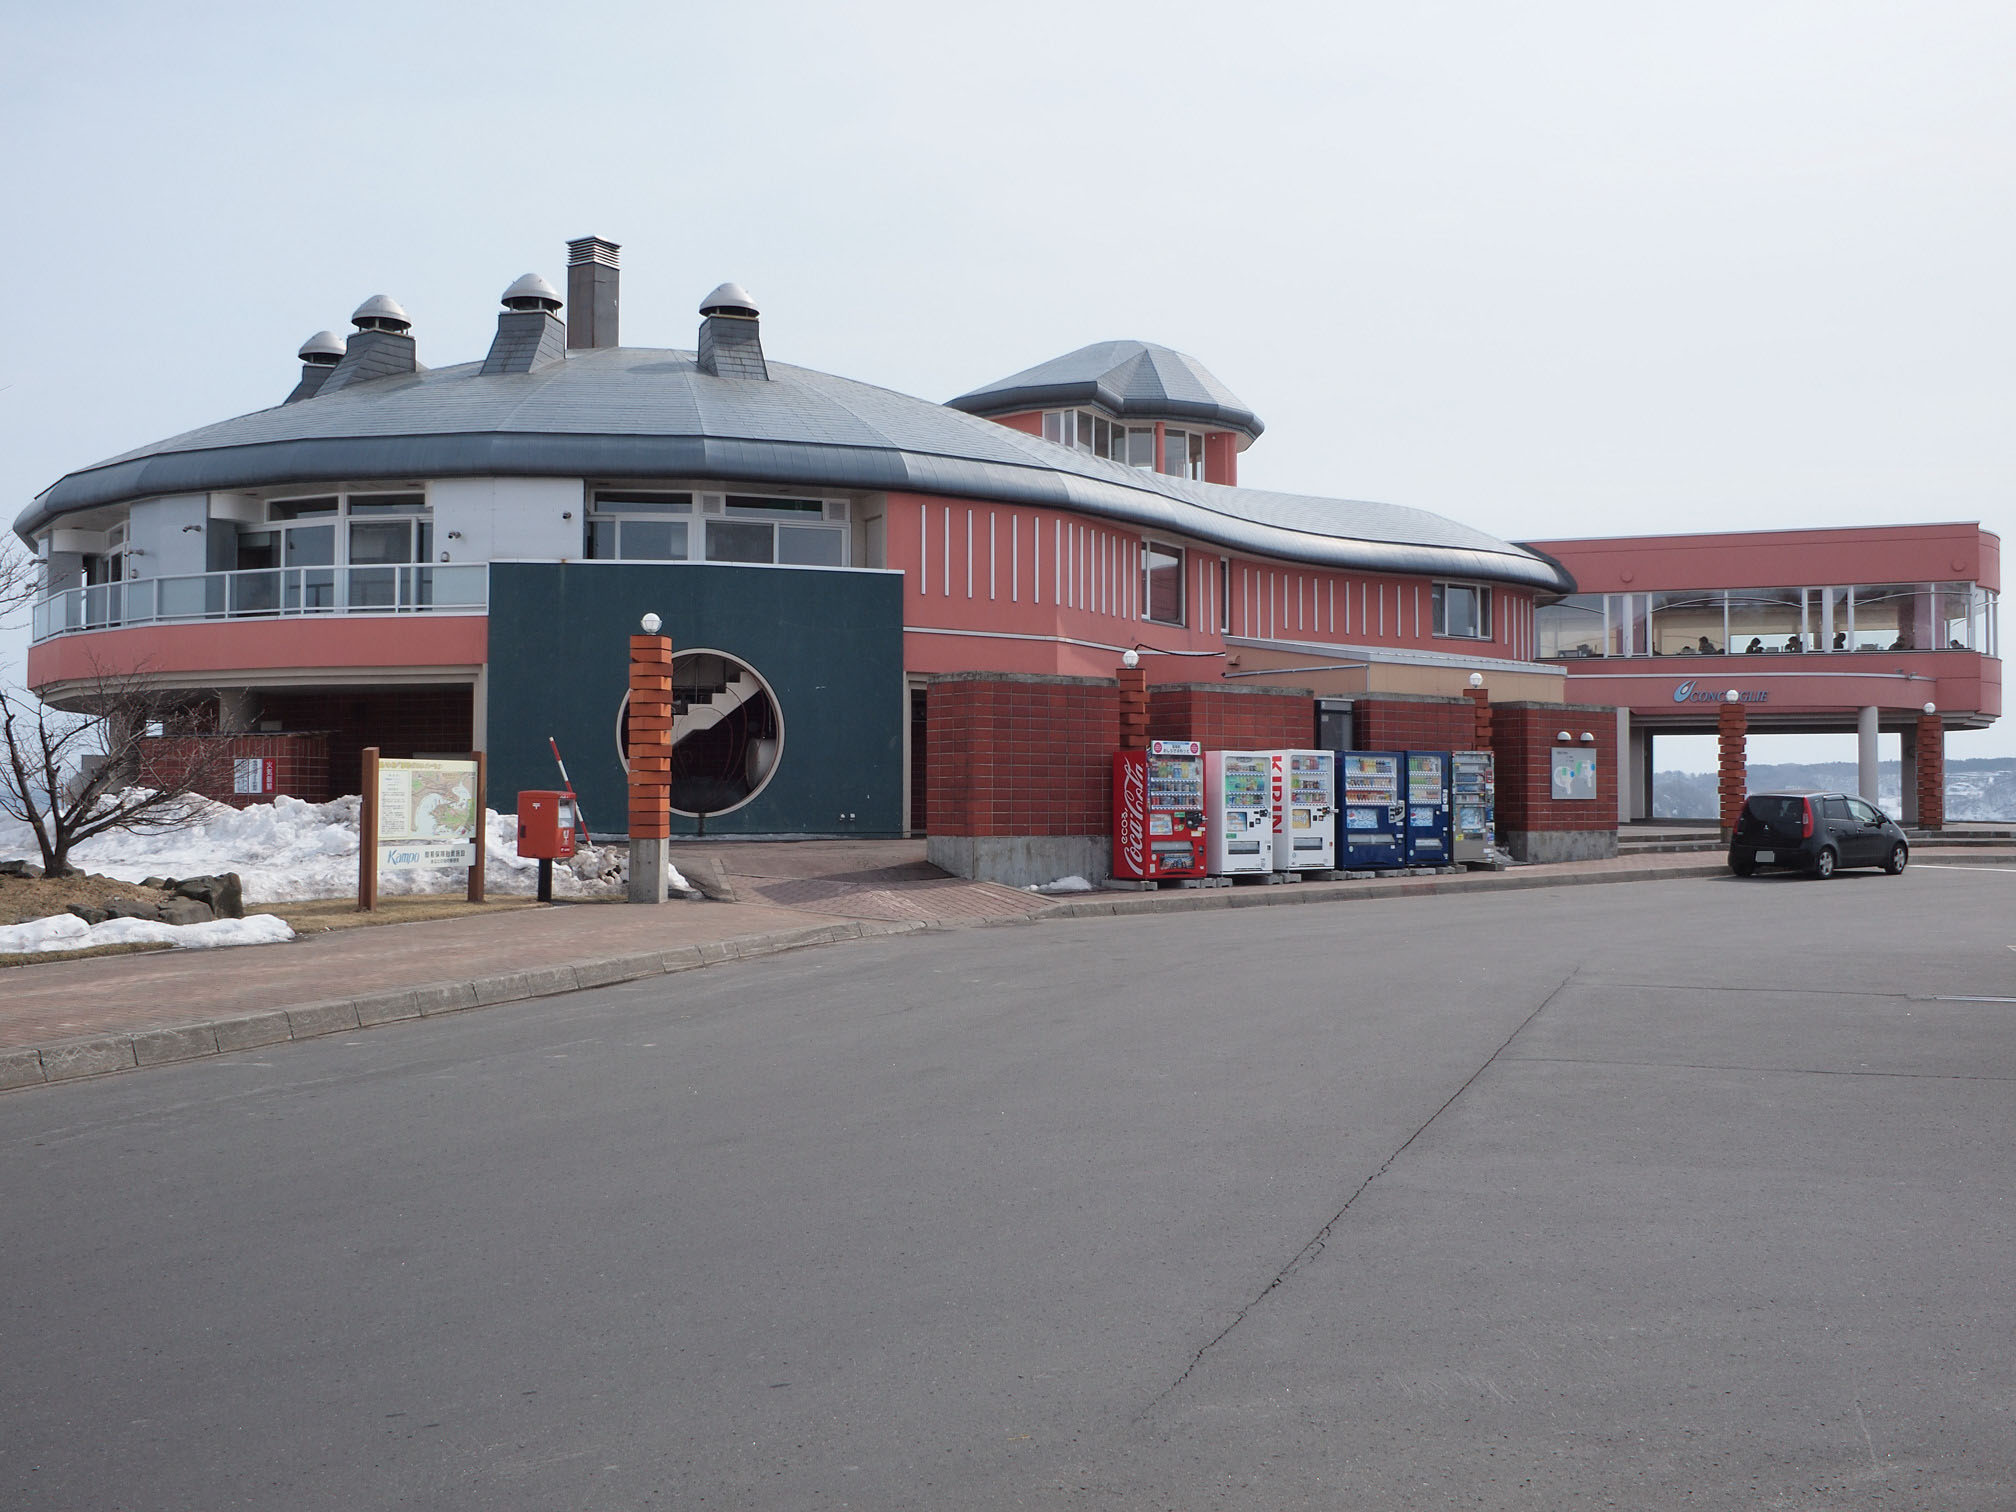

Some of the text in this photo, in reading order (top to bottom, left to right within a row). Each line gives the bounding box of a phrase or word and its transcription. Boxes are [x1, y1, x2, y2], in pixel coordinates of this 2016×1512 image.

[1690, 690, 1768, 703] CONCGLIE
[1124, 756, 1144, 876] Coca-Cola
[1272, 756, 1282, 834] KIRIN
[387, 849, 420, 865] Kampo
